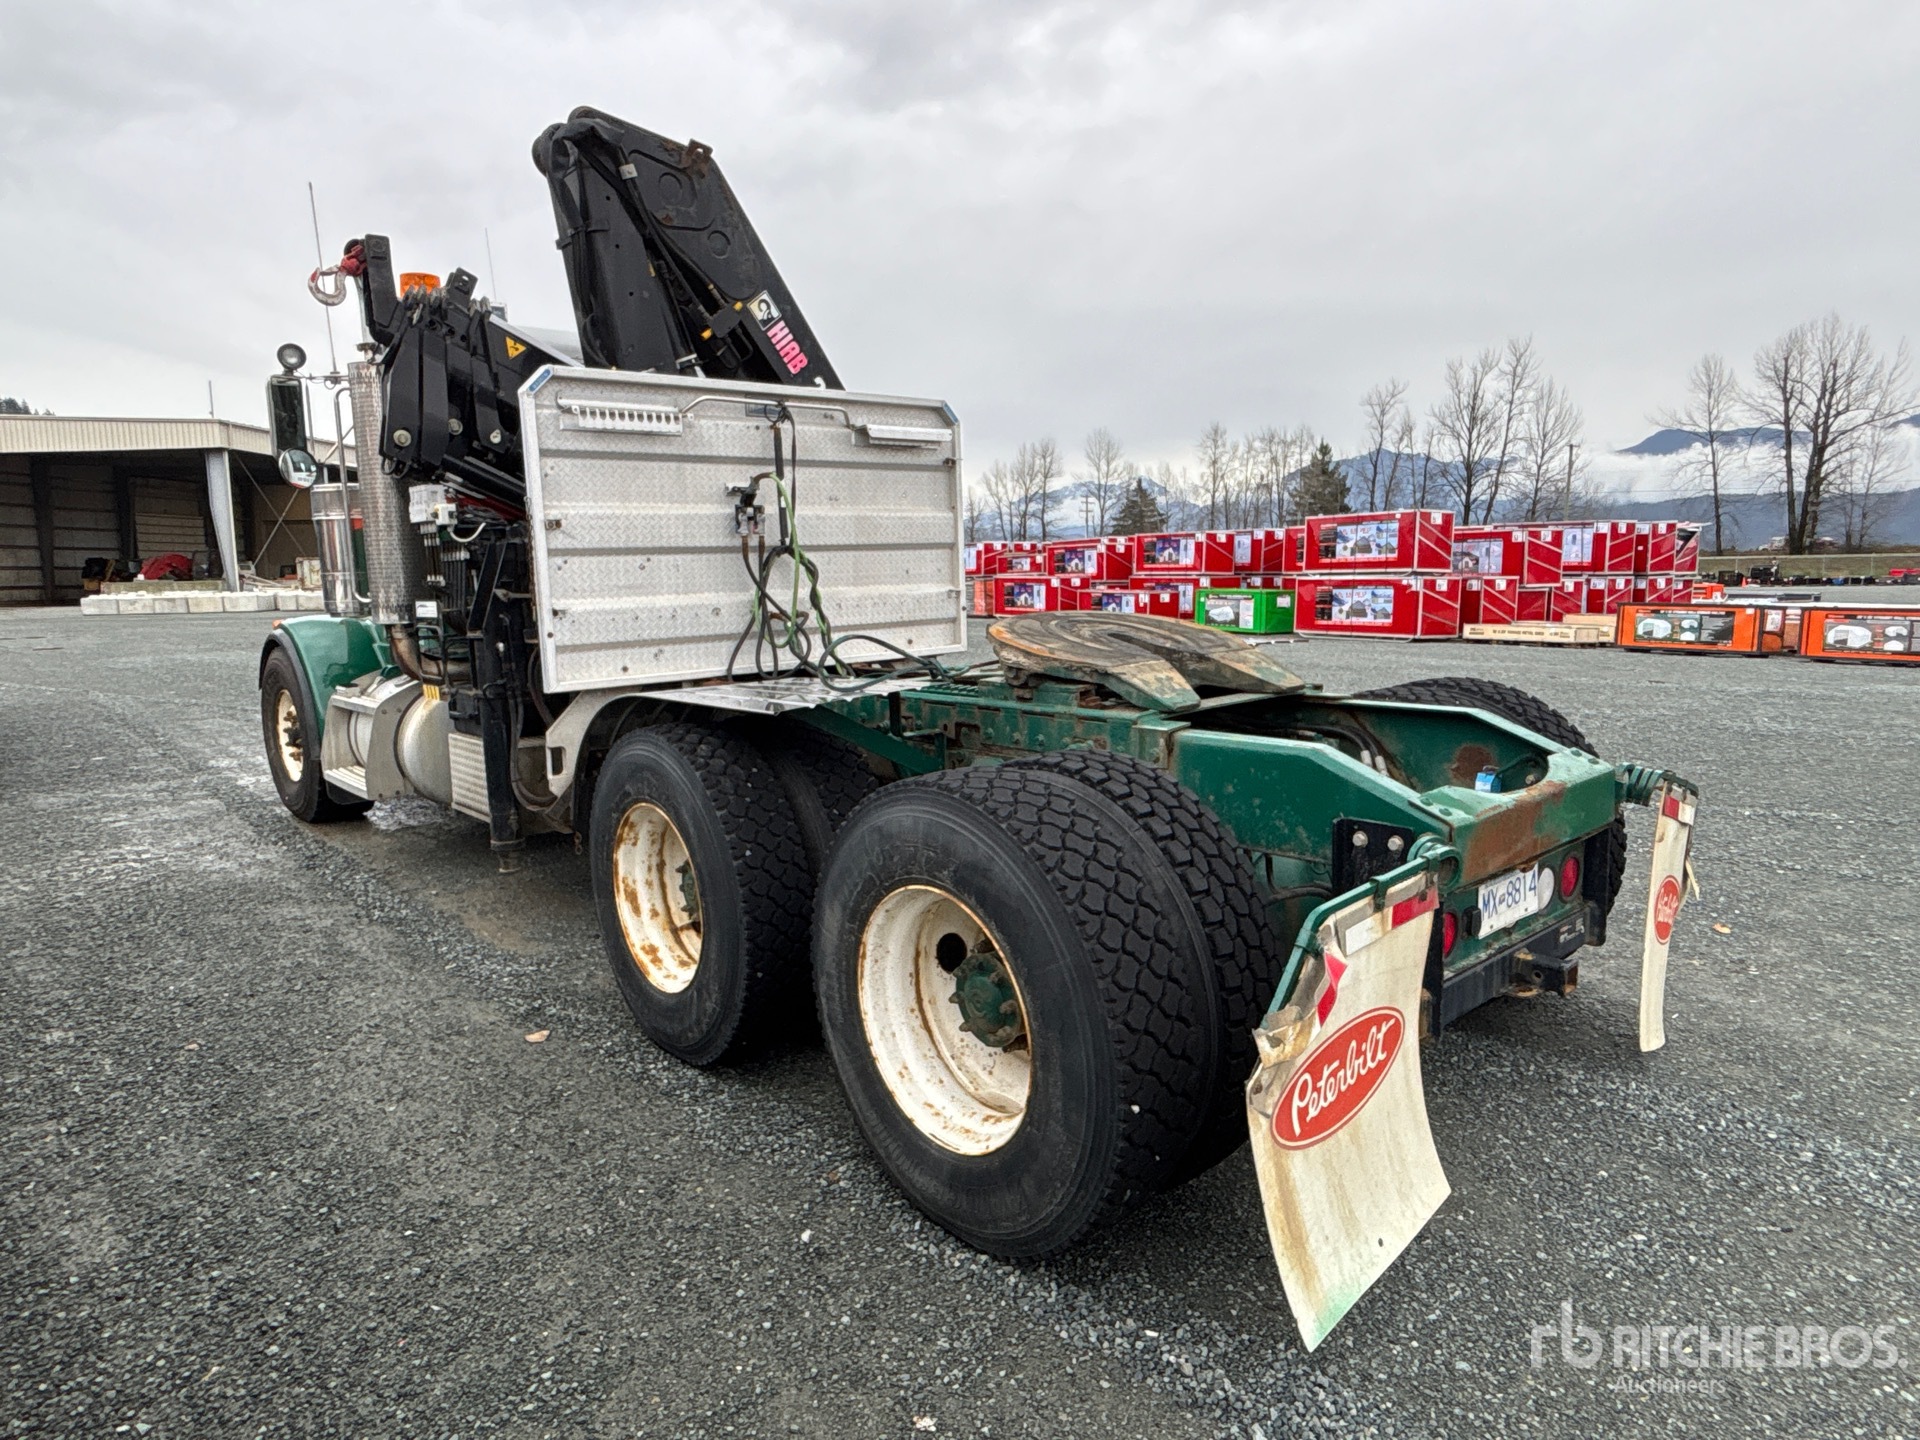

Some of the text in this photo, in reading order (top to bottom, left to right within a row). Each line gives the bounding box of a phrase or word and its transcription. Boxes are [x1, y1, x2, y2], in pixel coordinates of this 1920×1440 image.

[766, 320, 808, 374] HIAB
[1482, 869, 1537, 921] MX 8814
[1291, 1018, 1396, 1137] Peterbilt
